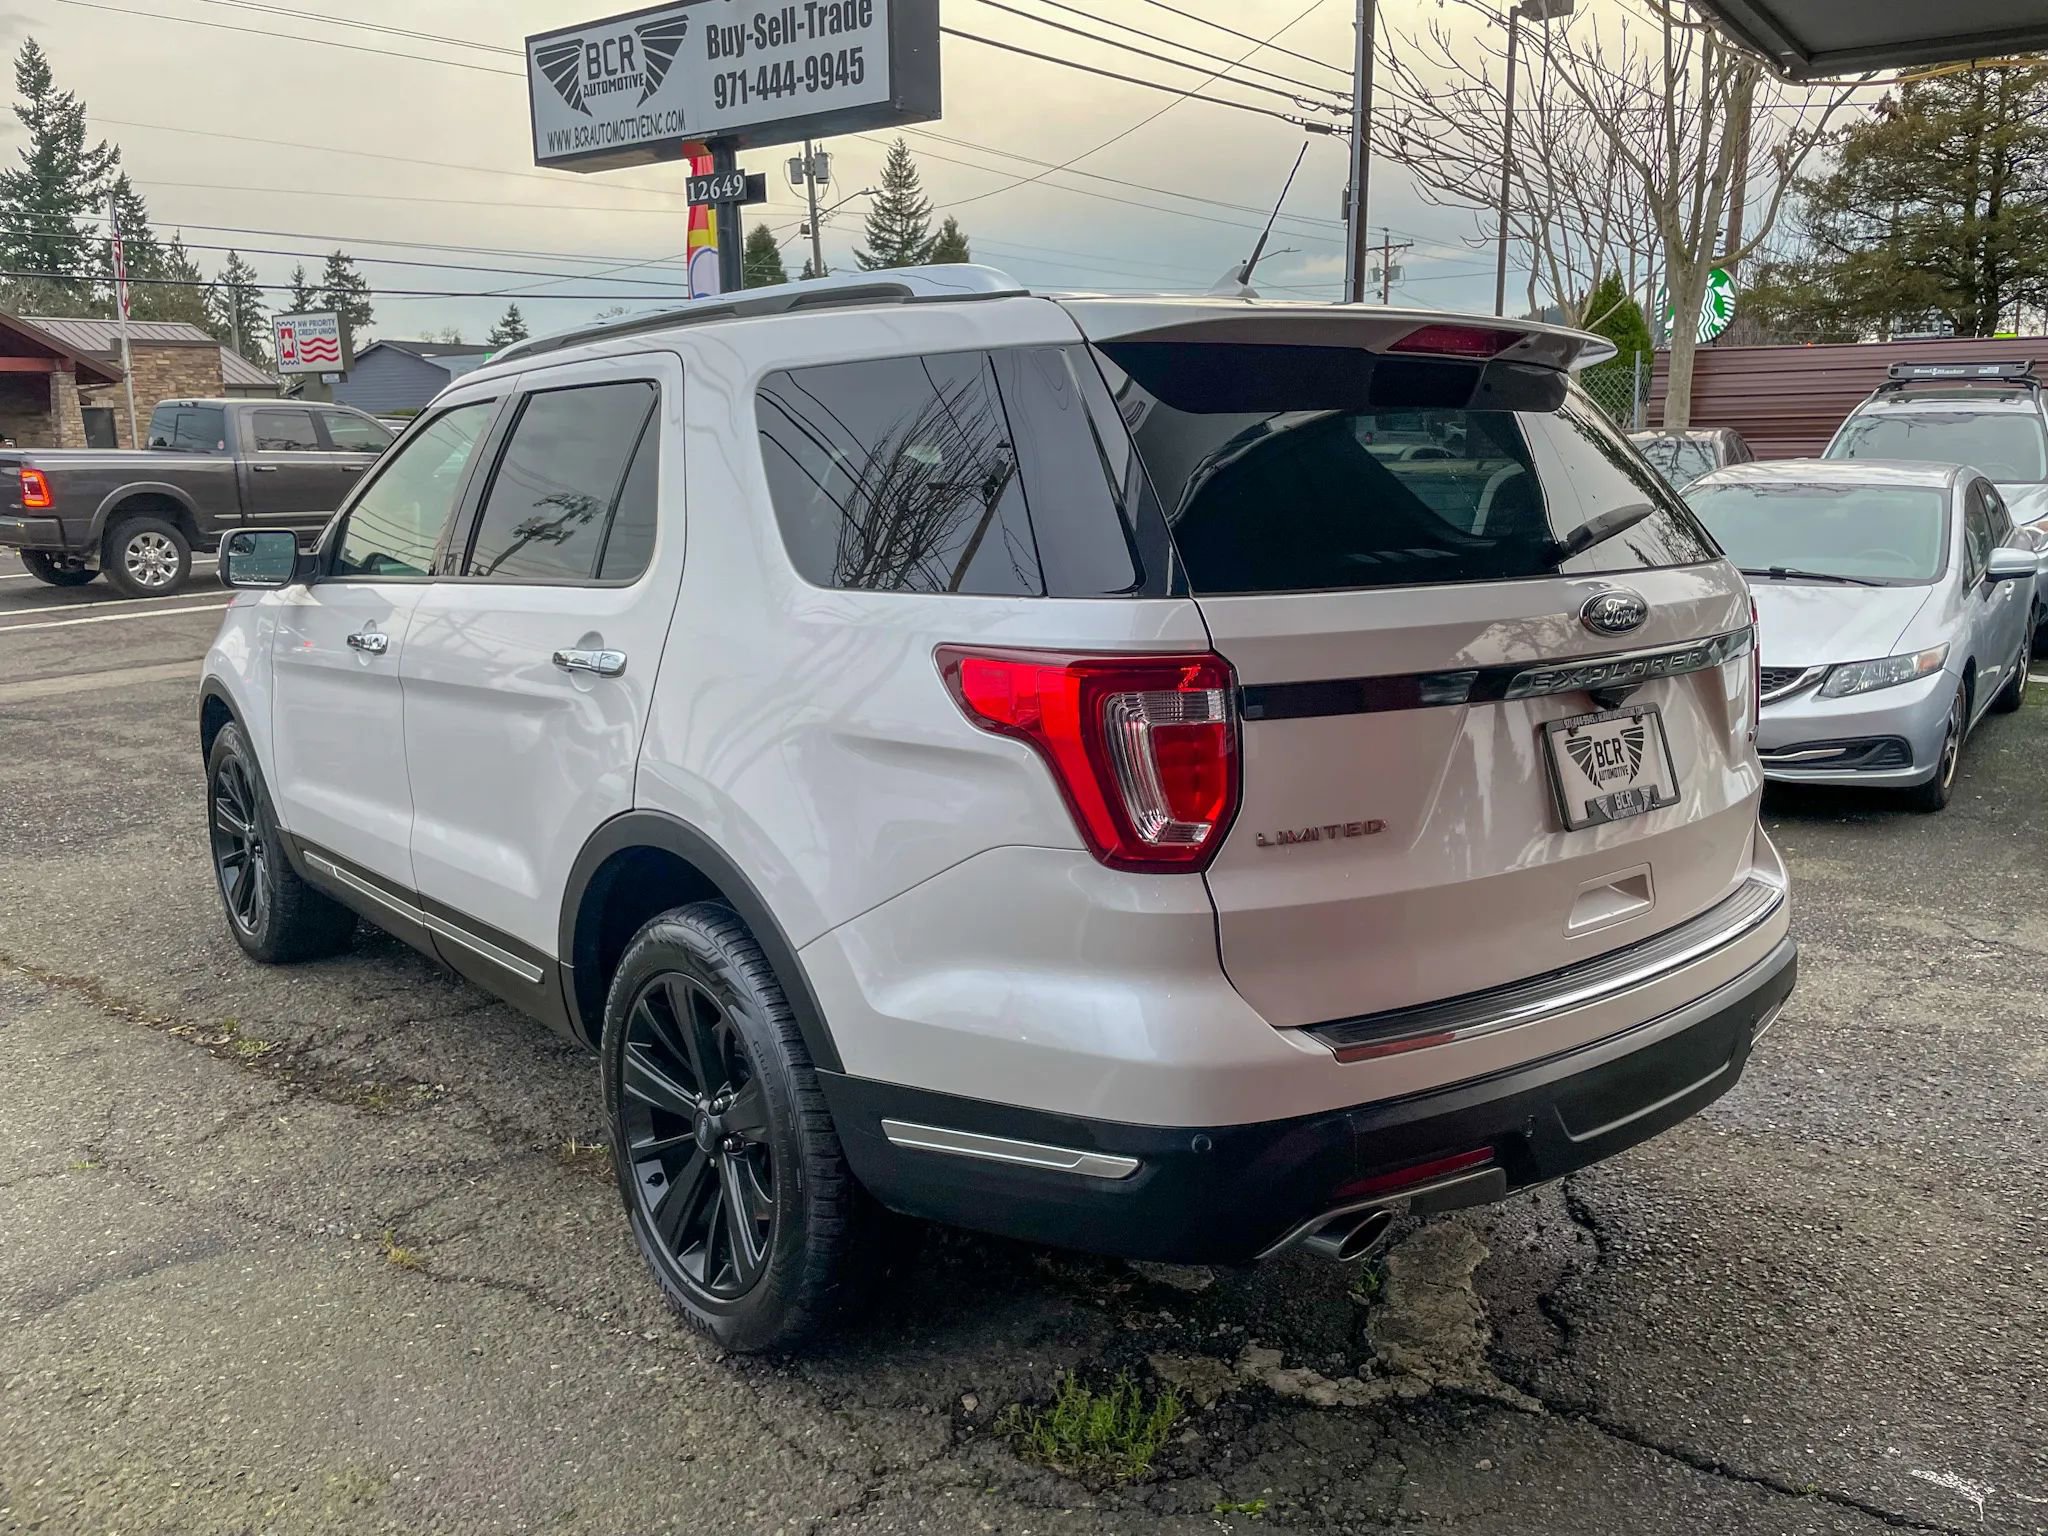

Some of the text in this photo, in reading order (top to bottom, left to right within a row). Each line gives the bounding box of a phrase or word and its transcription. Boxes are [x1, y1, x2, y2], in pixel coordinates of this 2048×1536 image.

[706, 0, 873, 60] Buy-Sell-Trade
[585, 34, 636, 80] BCR
[583, 73, 645, 98] AUTOMOTIVE
[714, 46, 865, 109] 971-444-9945
[547, 108, 686, 152] WWW.BCRAUTOMOTIVEINC.COM
[688, 174, 744, 202] 12649
[298, 327, 336, 336] CREDIT UNION
[309, 318, 336, 327] PRIORITY
[1604, 599, 1640, 626] Ford
[1529, 651, 1702, 690] EXPLORER
[1593, 737, 1625, 768] BCR
[1599, 765, 1630, 781] AUTOMOTIVE
[1614, 790, 1634, 810] BCR
[1255, 819, 1389, 847] LIMITED
